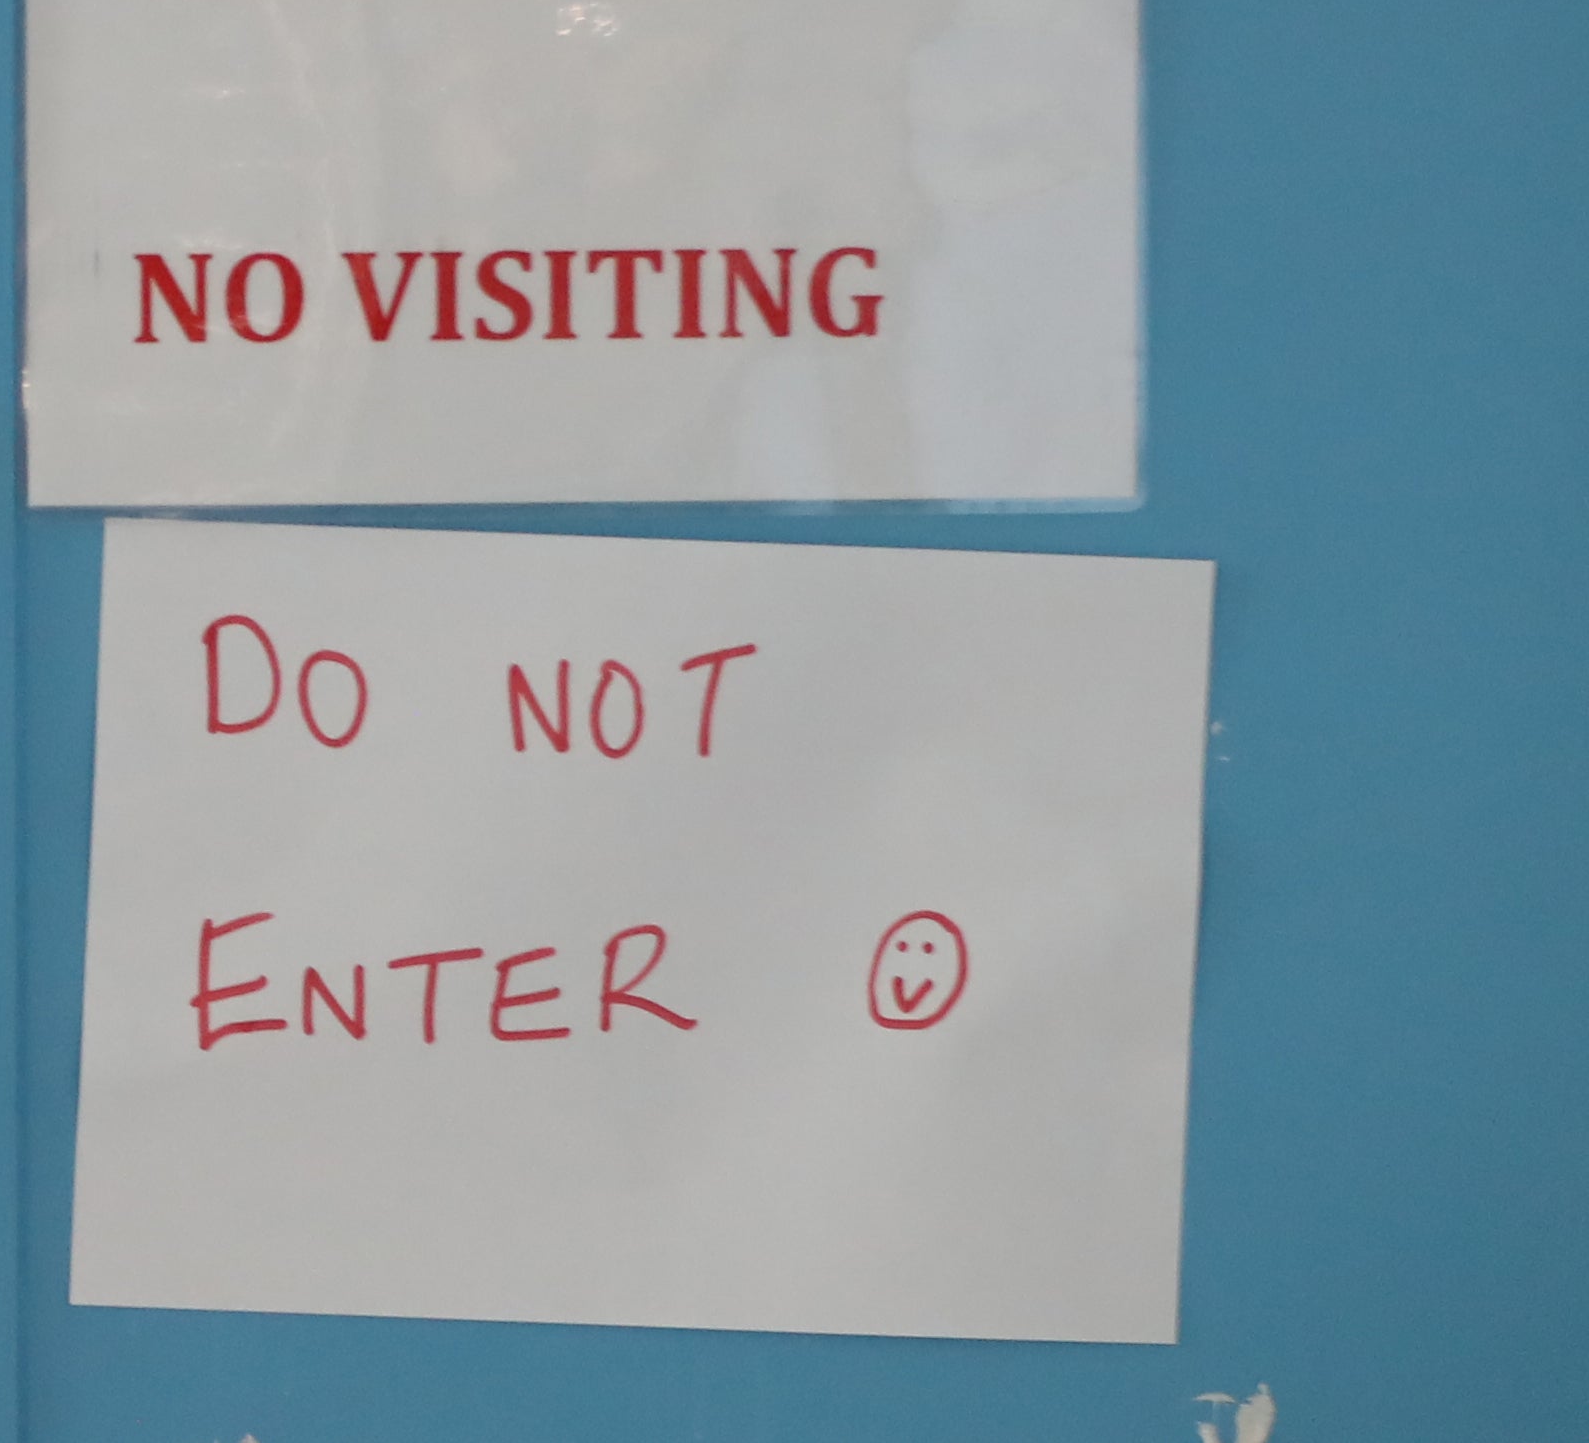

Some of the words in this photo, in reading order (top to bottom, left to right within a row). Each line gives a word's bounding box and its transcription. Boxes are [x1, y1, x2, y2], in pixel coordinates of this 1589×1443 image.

[135, 252, 305, 343] NO
[343, 247, 883, 342] VISITING
[203, 615, 368, 748] DO
[508, 644, 757, 758] NOT
[190, 913, 697, 1050] ENTER
